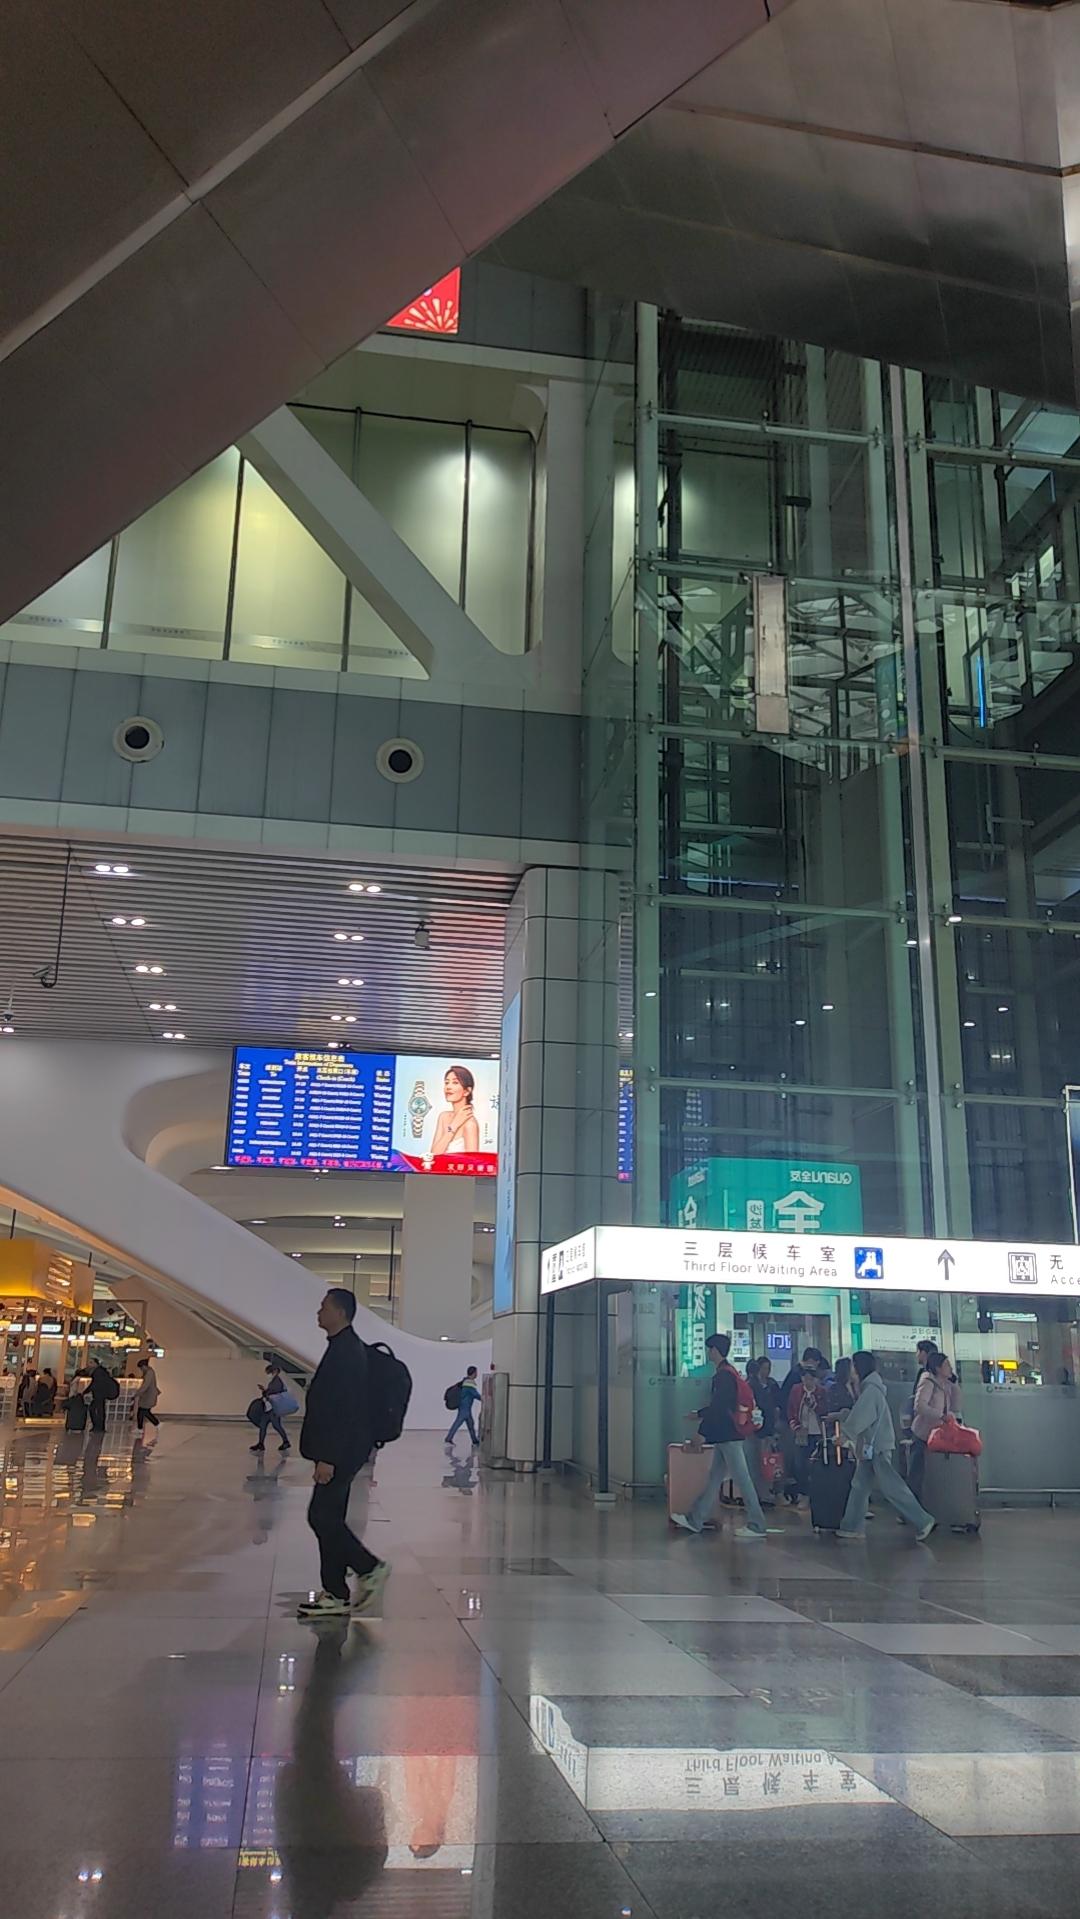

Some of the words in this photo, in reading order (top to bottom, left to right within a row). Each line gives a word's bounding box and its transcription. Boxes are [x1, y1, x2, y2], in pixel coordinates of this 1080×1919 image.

[683, 1240, 836, 1263] 三层候车室
[683, 1260, 716, 1273] Third
[720, 1262, 753, 1274] Floor
[757, 1264, 805, 1278] Waiting
[809, 1266, 838, 1277] Area
[1049, 1254, 1064, 1270] 无
